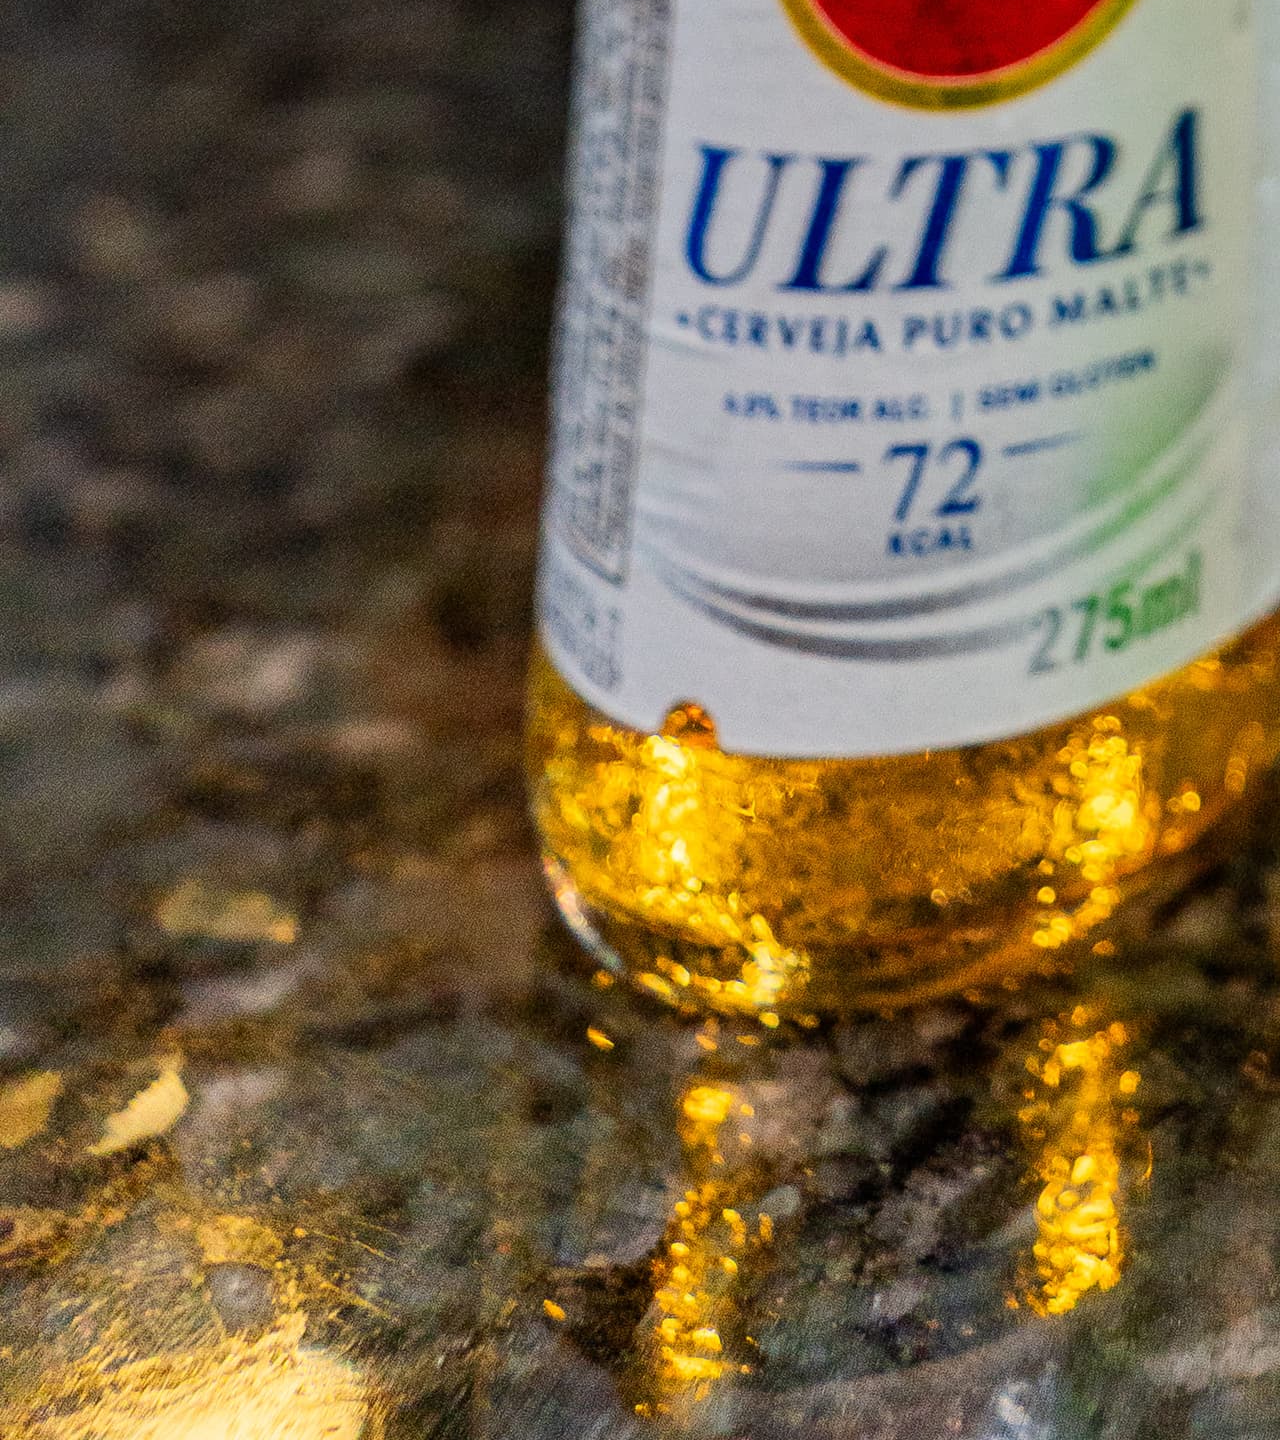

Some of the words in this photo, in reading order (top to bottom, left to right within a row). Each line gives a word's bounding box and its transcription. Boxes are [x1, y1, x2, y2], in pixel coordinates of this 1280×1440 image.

[683, 104, 1211, 296] ULTRA
[699, 302, 883, 360] CERVEJA
[902, 302, 1035, 350] PURO
[1047, 261, 1192, 326] MALTE
[883, 438, 984, 522] 72
[1027, 550, 1200, 678] 275ml
